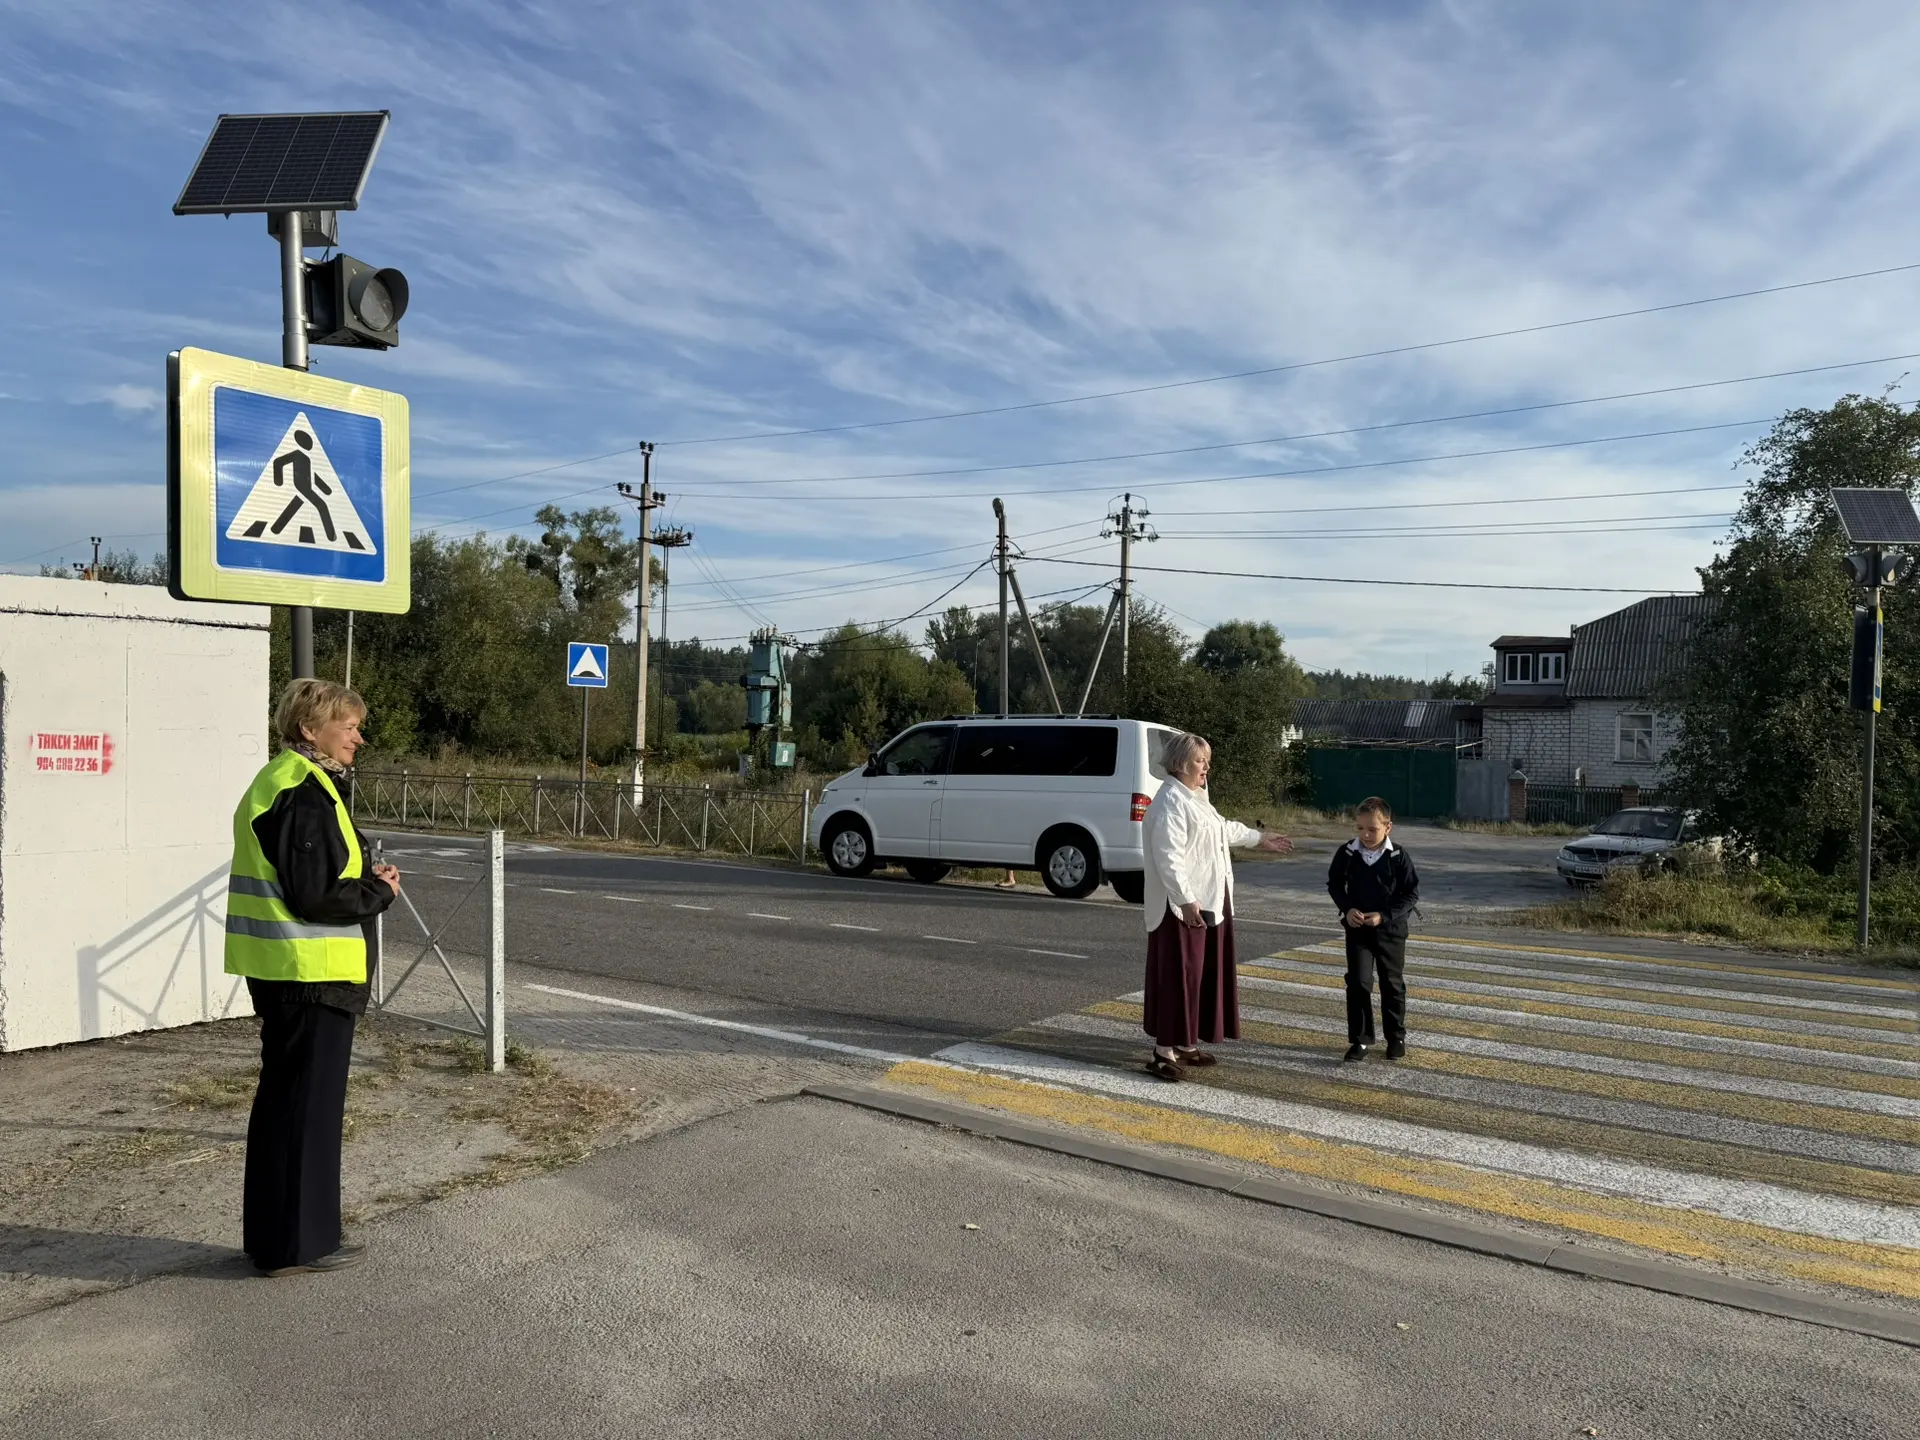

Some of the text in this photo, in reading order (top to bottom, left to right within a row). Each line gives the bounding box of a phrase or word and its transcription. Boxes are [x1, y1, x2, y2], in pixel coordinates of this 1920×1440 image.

[37, 733, 99, 751] ТАКСИ ЭЛИТ
[36, 756, 54, 770] 904
[74, 757, 86, 771] 22
[86, 757, 98, 772] 36
